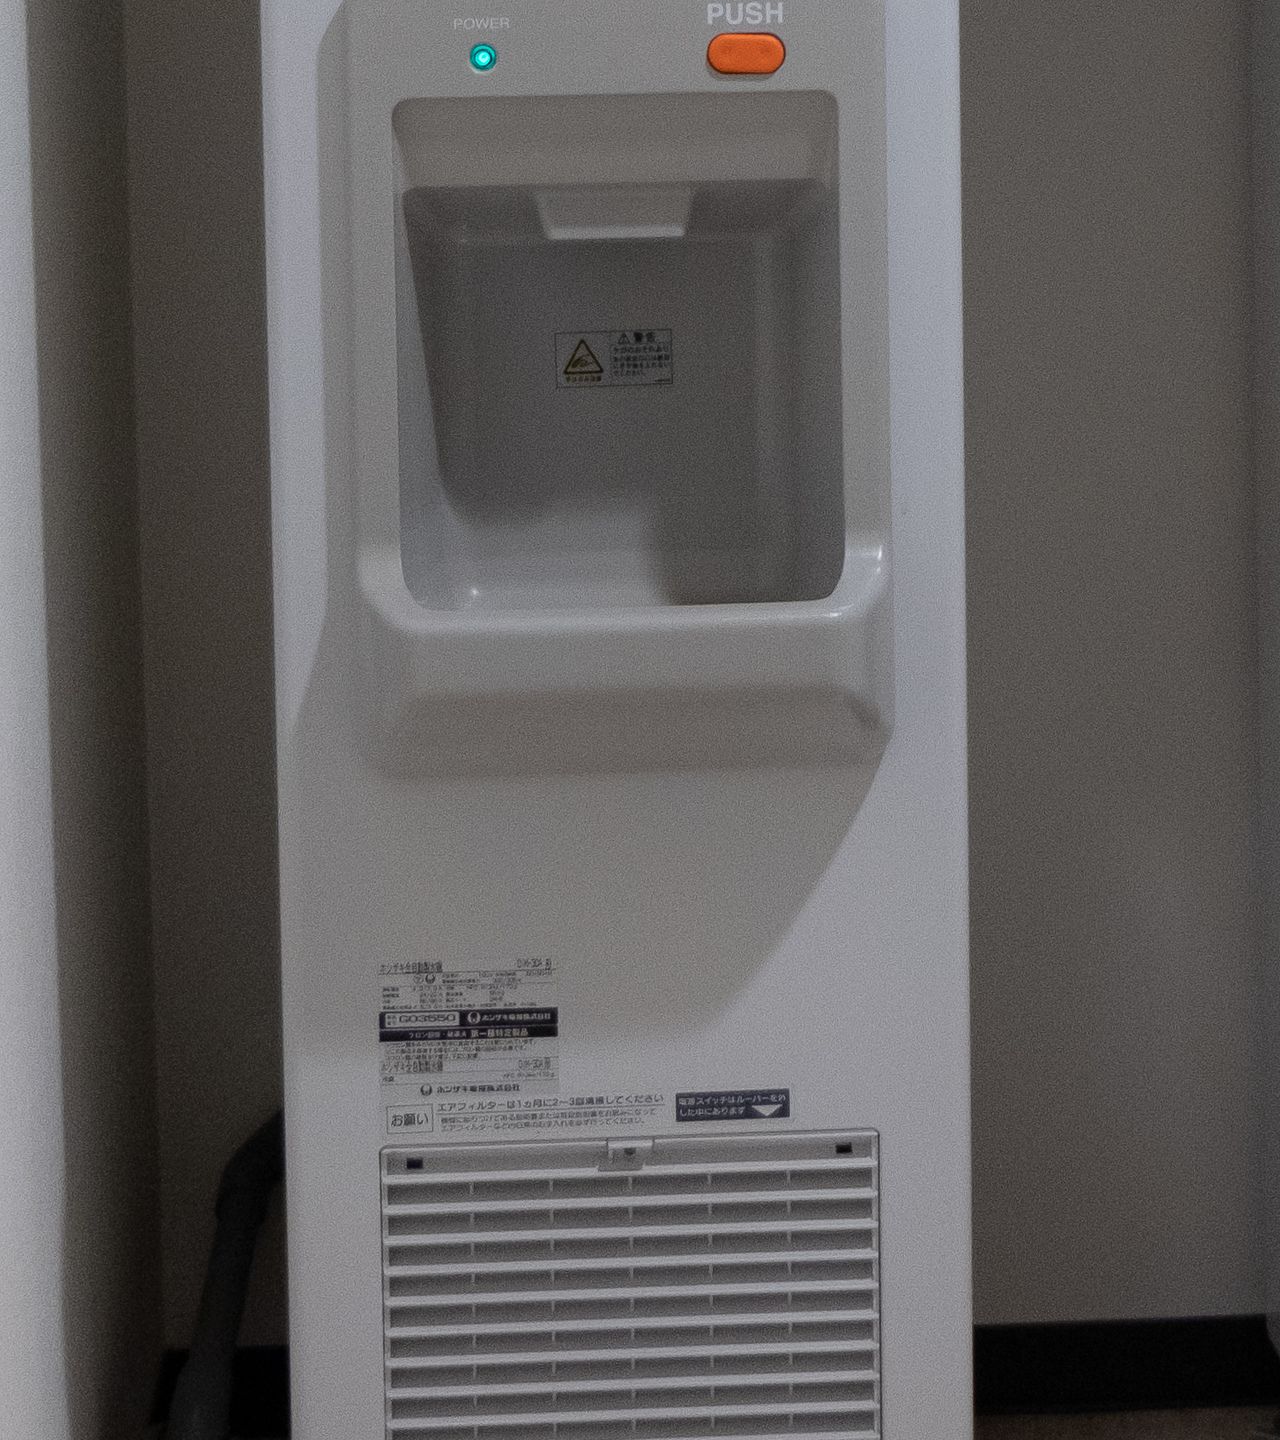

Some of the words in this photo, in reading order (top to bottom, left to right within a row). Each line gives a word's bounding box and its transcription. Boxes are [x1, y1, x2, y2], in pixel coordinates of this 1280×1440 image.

[706, 2, 785, 25] PUSH
[453, 16, 511, 30] POWER
[390, 1112, 430, 1128] お願い
